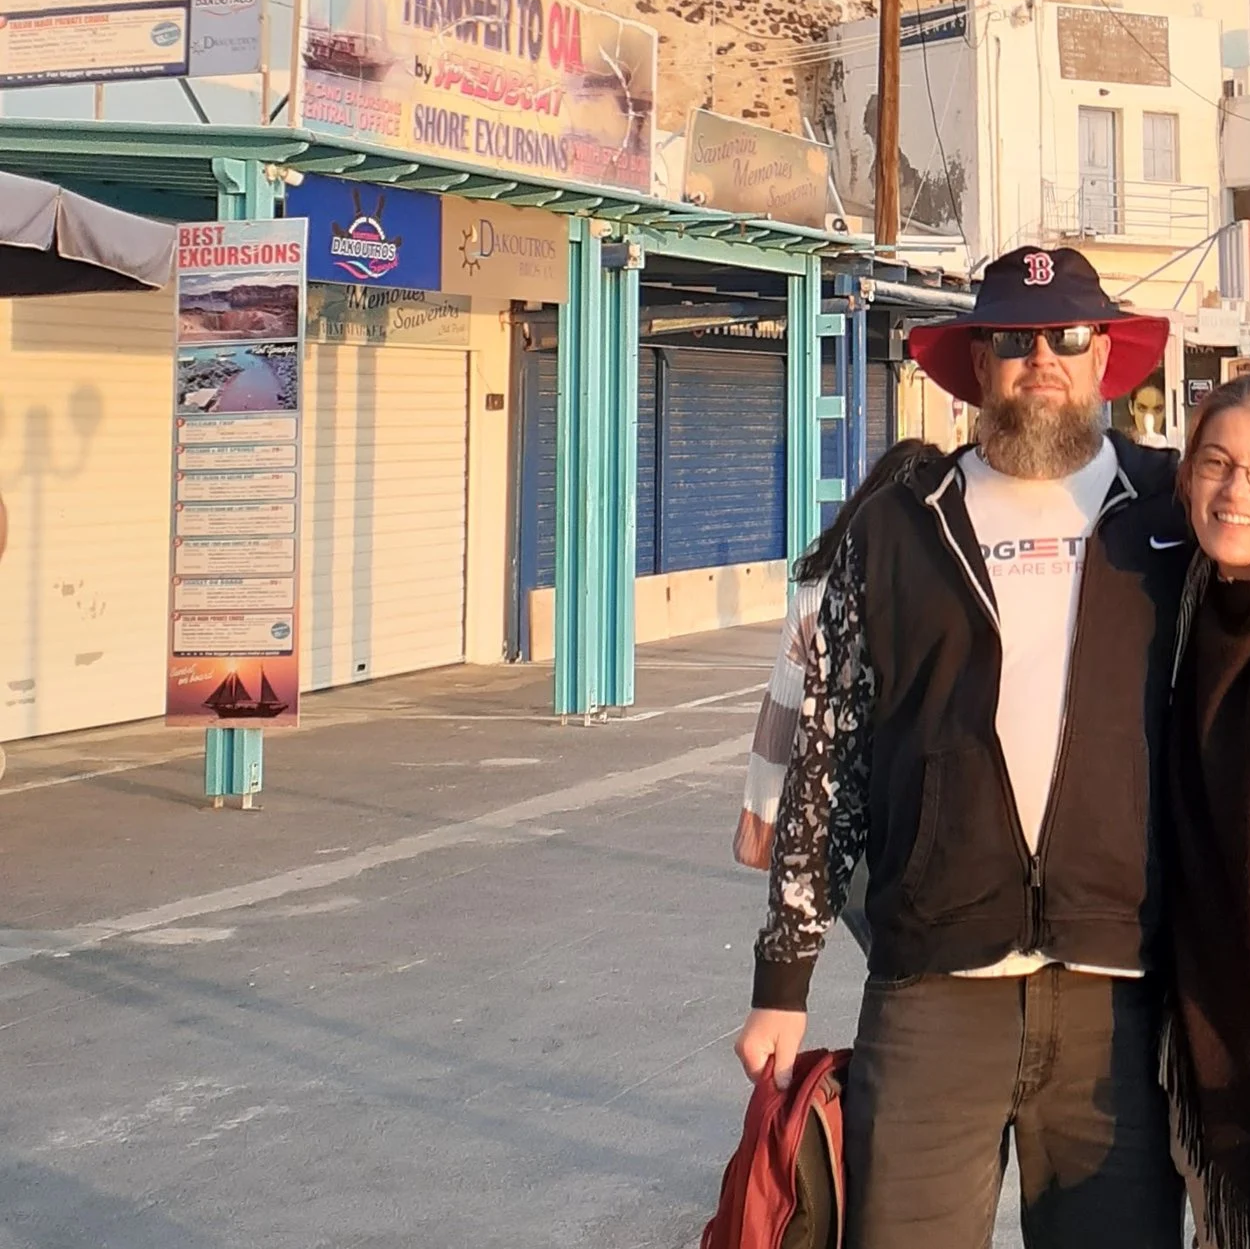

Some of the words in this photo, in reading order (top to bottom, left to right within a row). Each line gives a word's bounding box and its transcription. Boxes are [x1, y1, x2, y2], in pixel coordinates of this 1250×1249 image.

[547, 0, 584, 73] OIA
[414, 55, 432, 84] by
[433, 54, 567, 117] SPEEDBOAT
[356, 110, 400, 137] OFFICE
[414, 103, 471, 151] SHORE
[475, 117, 569, 172] EXCURSIONS
[694, 132, 757, 164] Santorini
[732, 154, 793, 188] Memories
[179, 226, 225, 247] BEST
[332, 237, 397, 260] DAKOUTROS
[1023, 251, 1055, 286] B
[393, 299, 460, 330] Souvenirs
[1008, 562, 1046, 576] ARE
